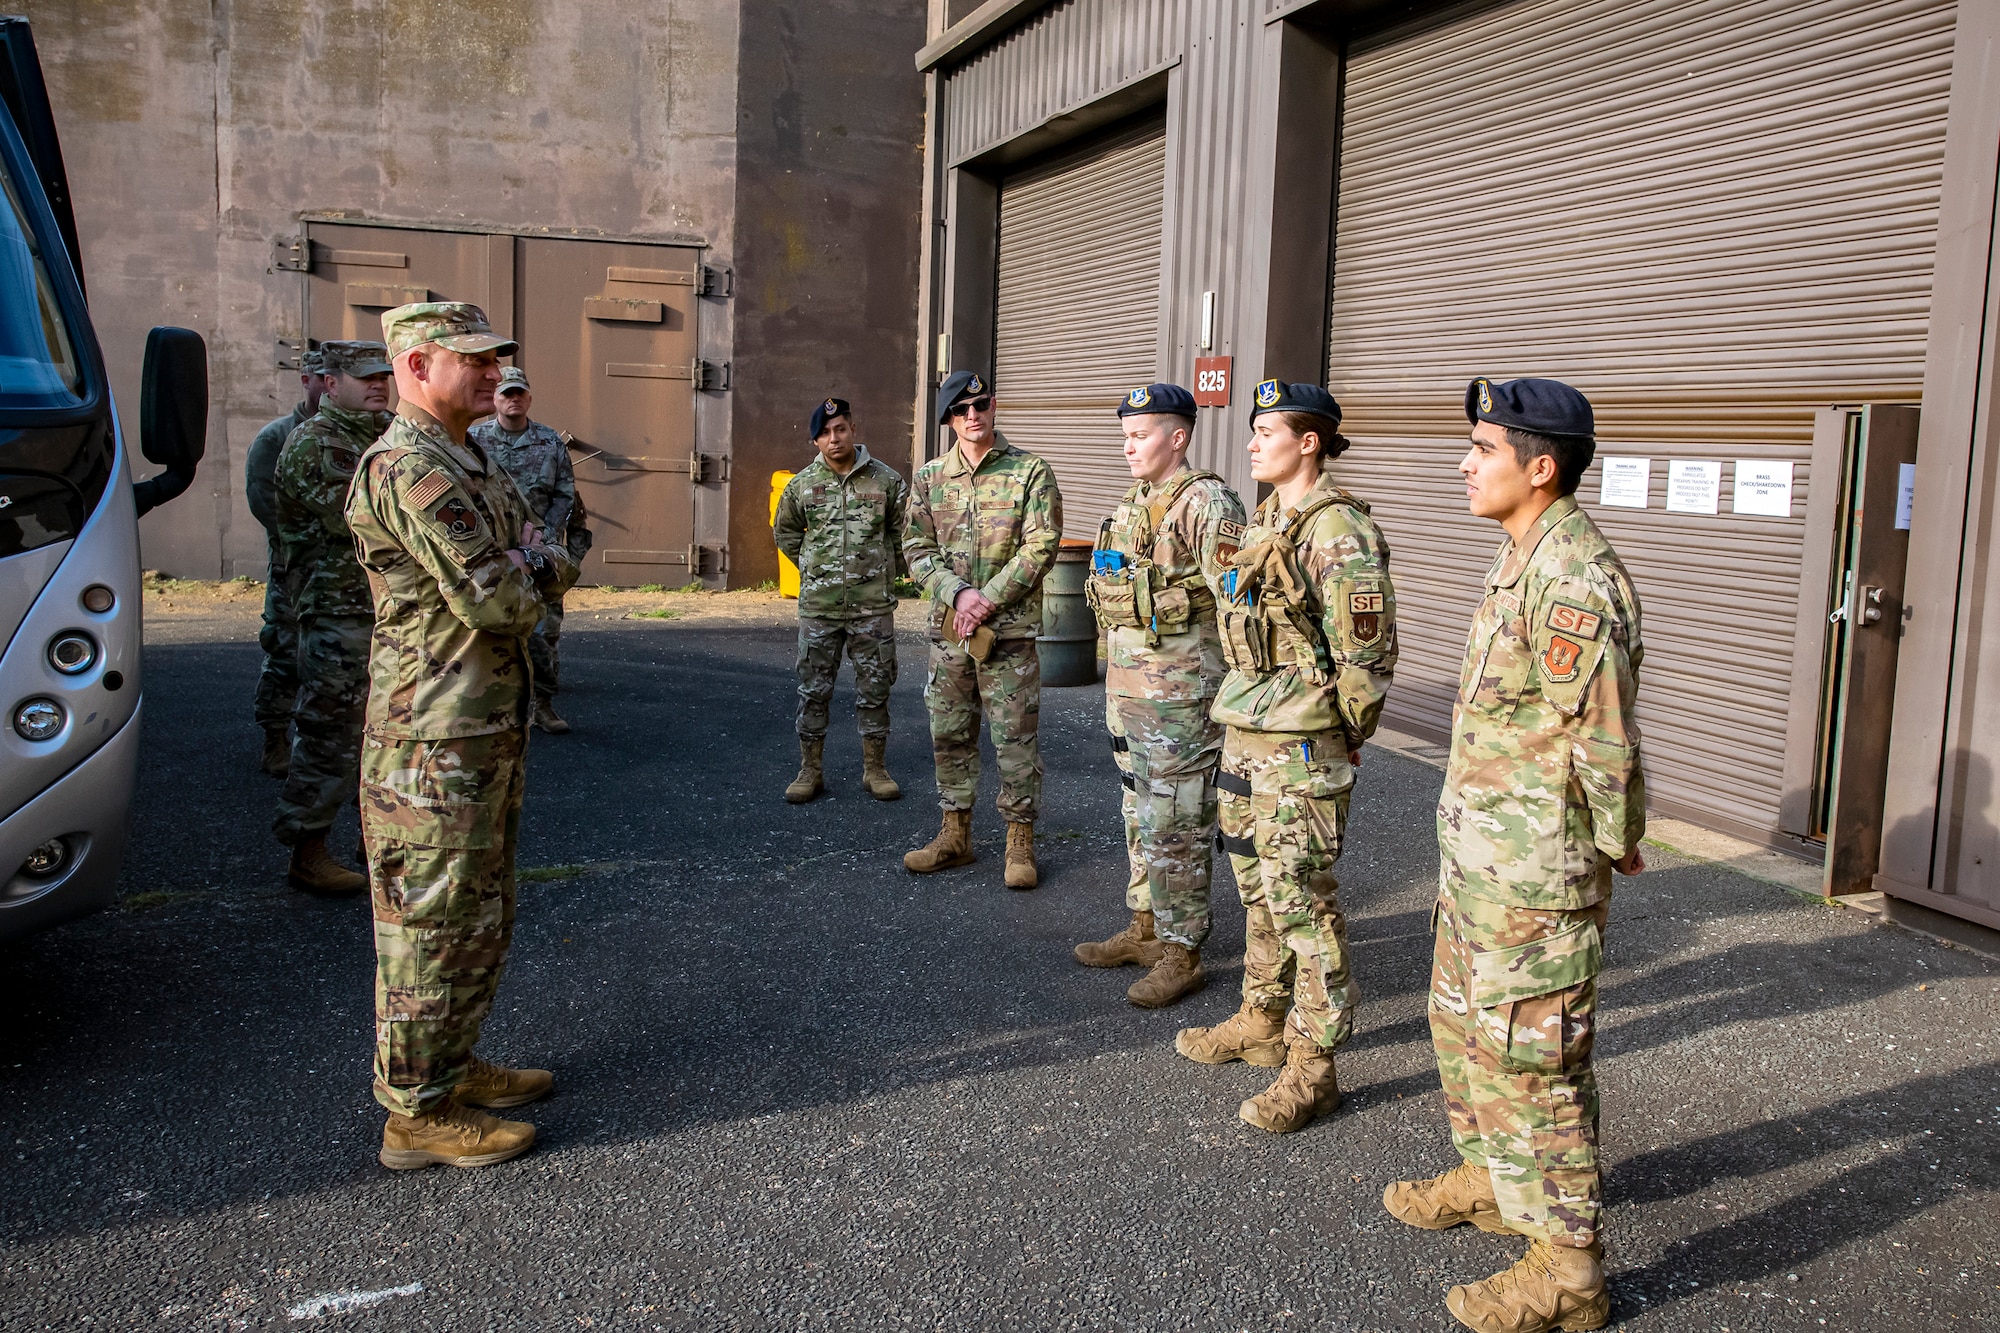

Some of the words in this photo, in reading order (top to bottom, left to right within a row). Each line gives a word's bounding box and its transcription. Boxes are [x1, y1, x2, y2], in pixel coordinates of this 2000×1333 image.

[1198, 370, 1226, 392] 825
[1740, 481, 1786, 489] CHECK/SHAKEDOWN
[1222, 522, 1244, 538] SF
[1353, 595, 1381, 611] SF
[1553, 607, 1598, 633] SF
